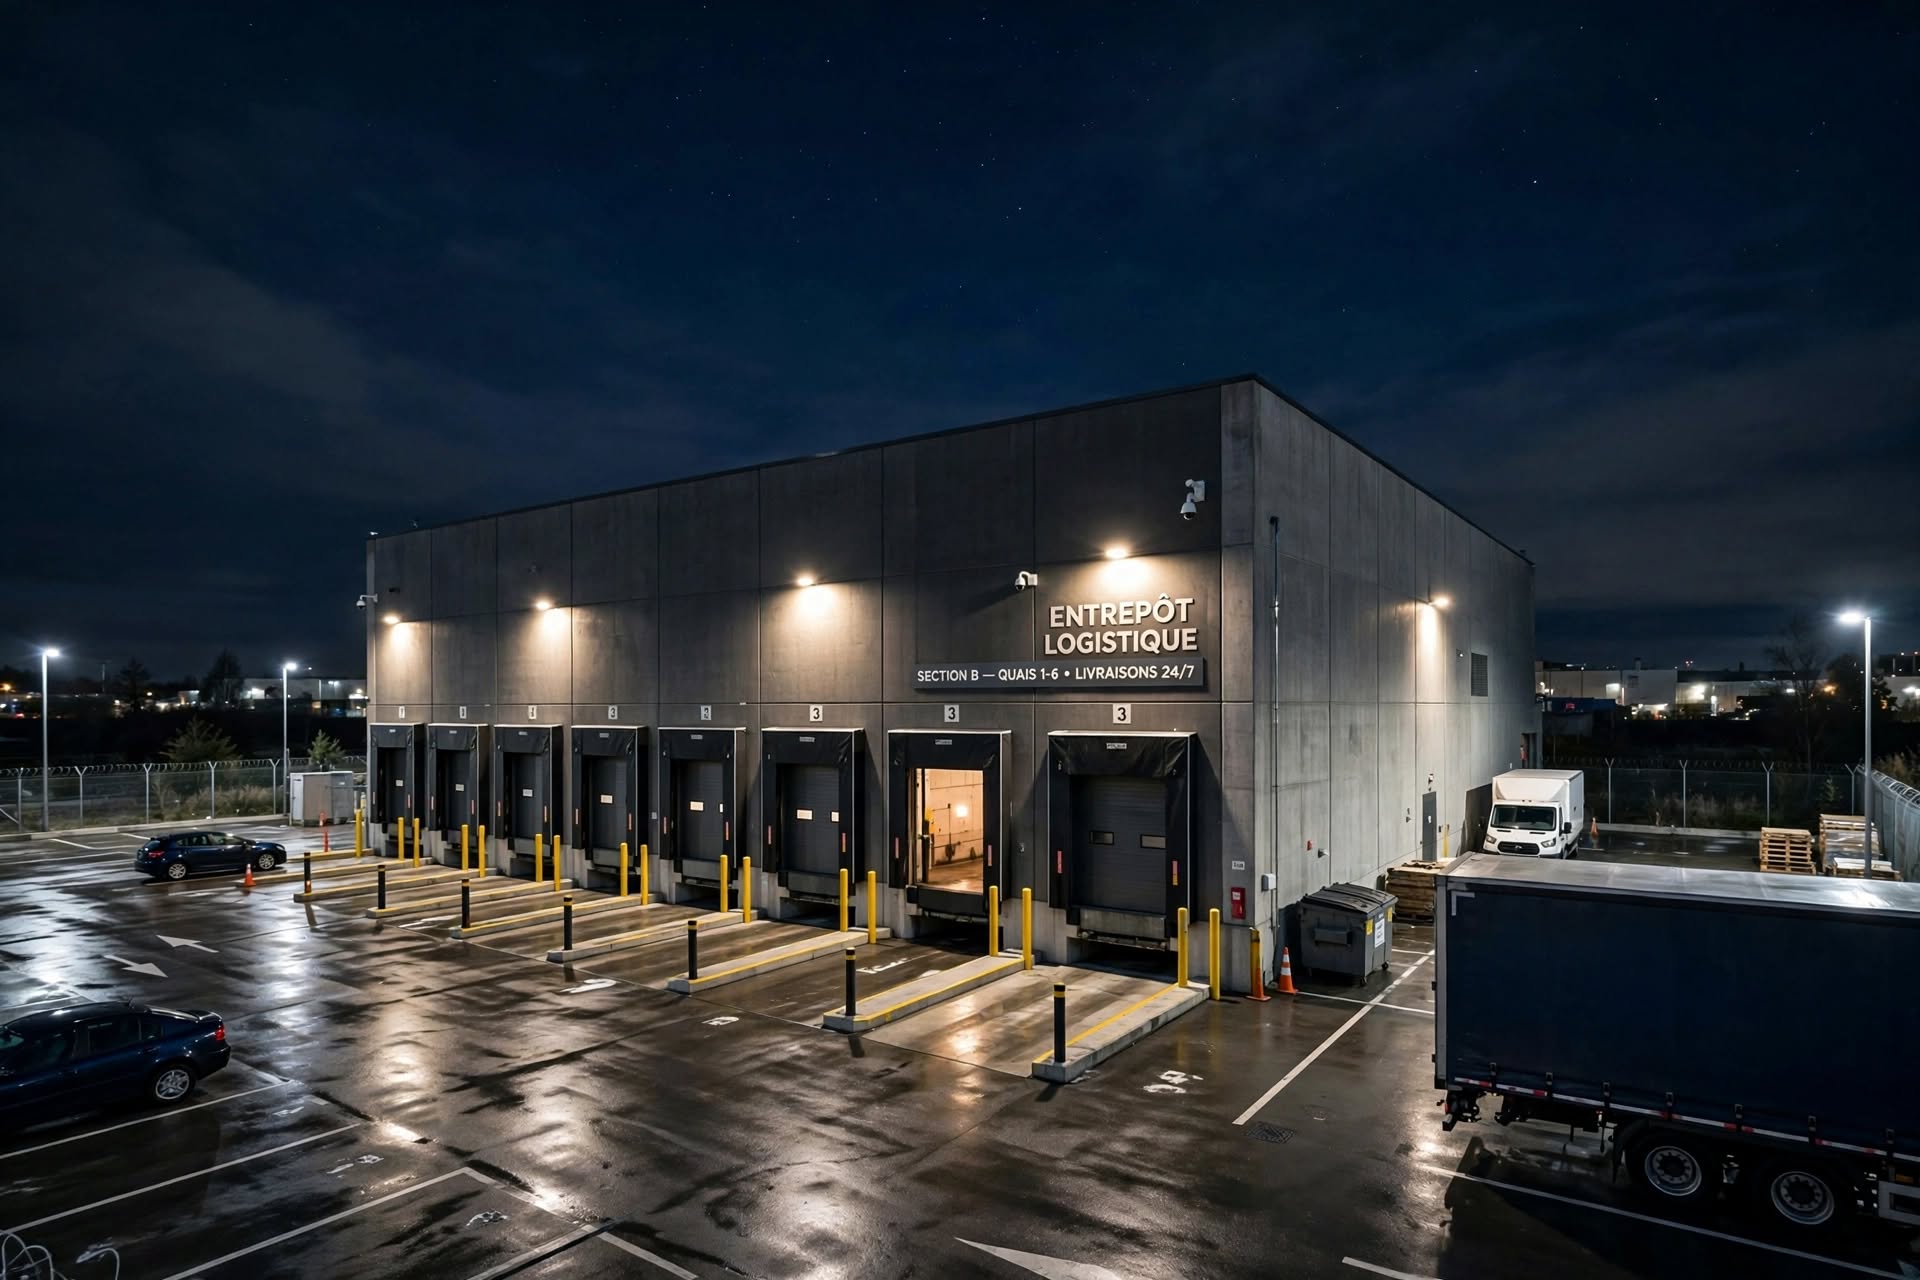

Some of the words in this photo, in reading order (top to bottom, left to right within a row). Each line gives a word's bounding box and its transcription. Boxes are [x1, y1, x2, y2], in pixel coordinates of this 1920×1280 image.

[1050, 593, 1194, 628] ENTREPÔT
[1045, 628, 1198, 655] LOGISTIQUE
[917, 669, 968, 682] SECTION
[971, 669, 979, 681] B
[998, 668, 1037, 681] QUAIS
[1041, 668, 1059, 680] 1-6
[1075, 665, 1158, 680] LIVRAISONS
[1161, 664, 1195, 680] 24/7
[812, 707, 820, 720] 3
[947, 706, 956, 720] 3
[1116, 706, 1127, 721] 3
